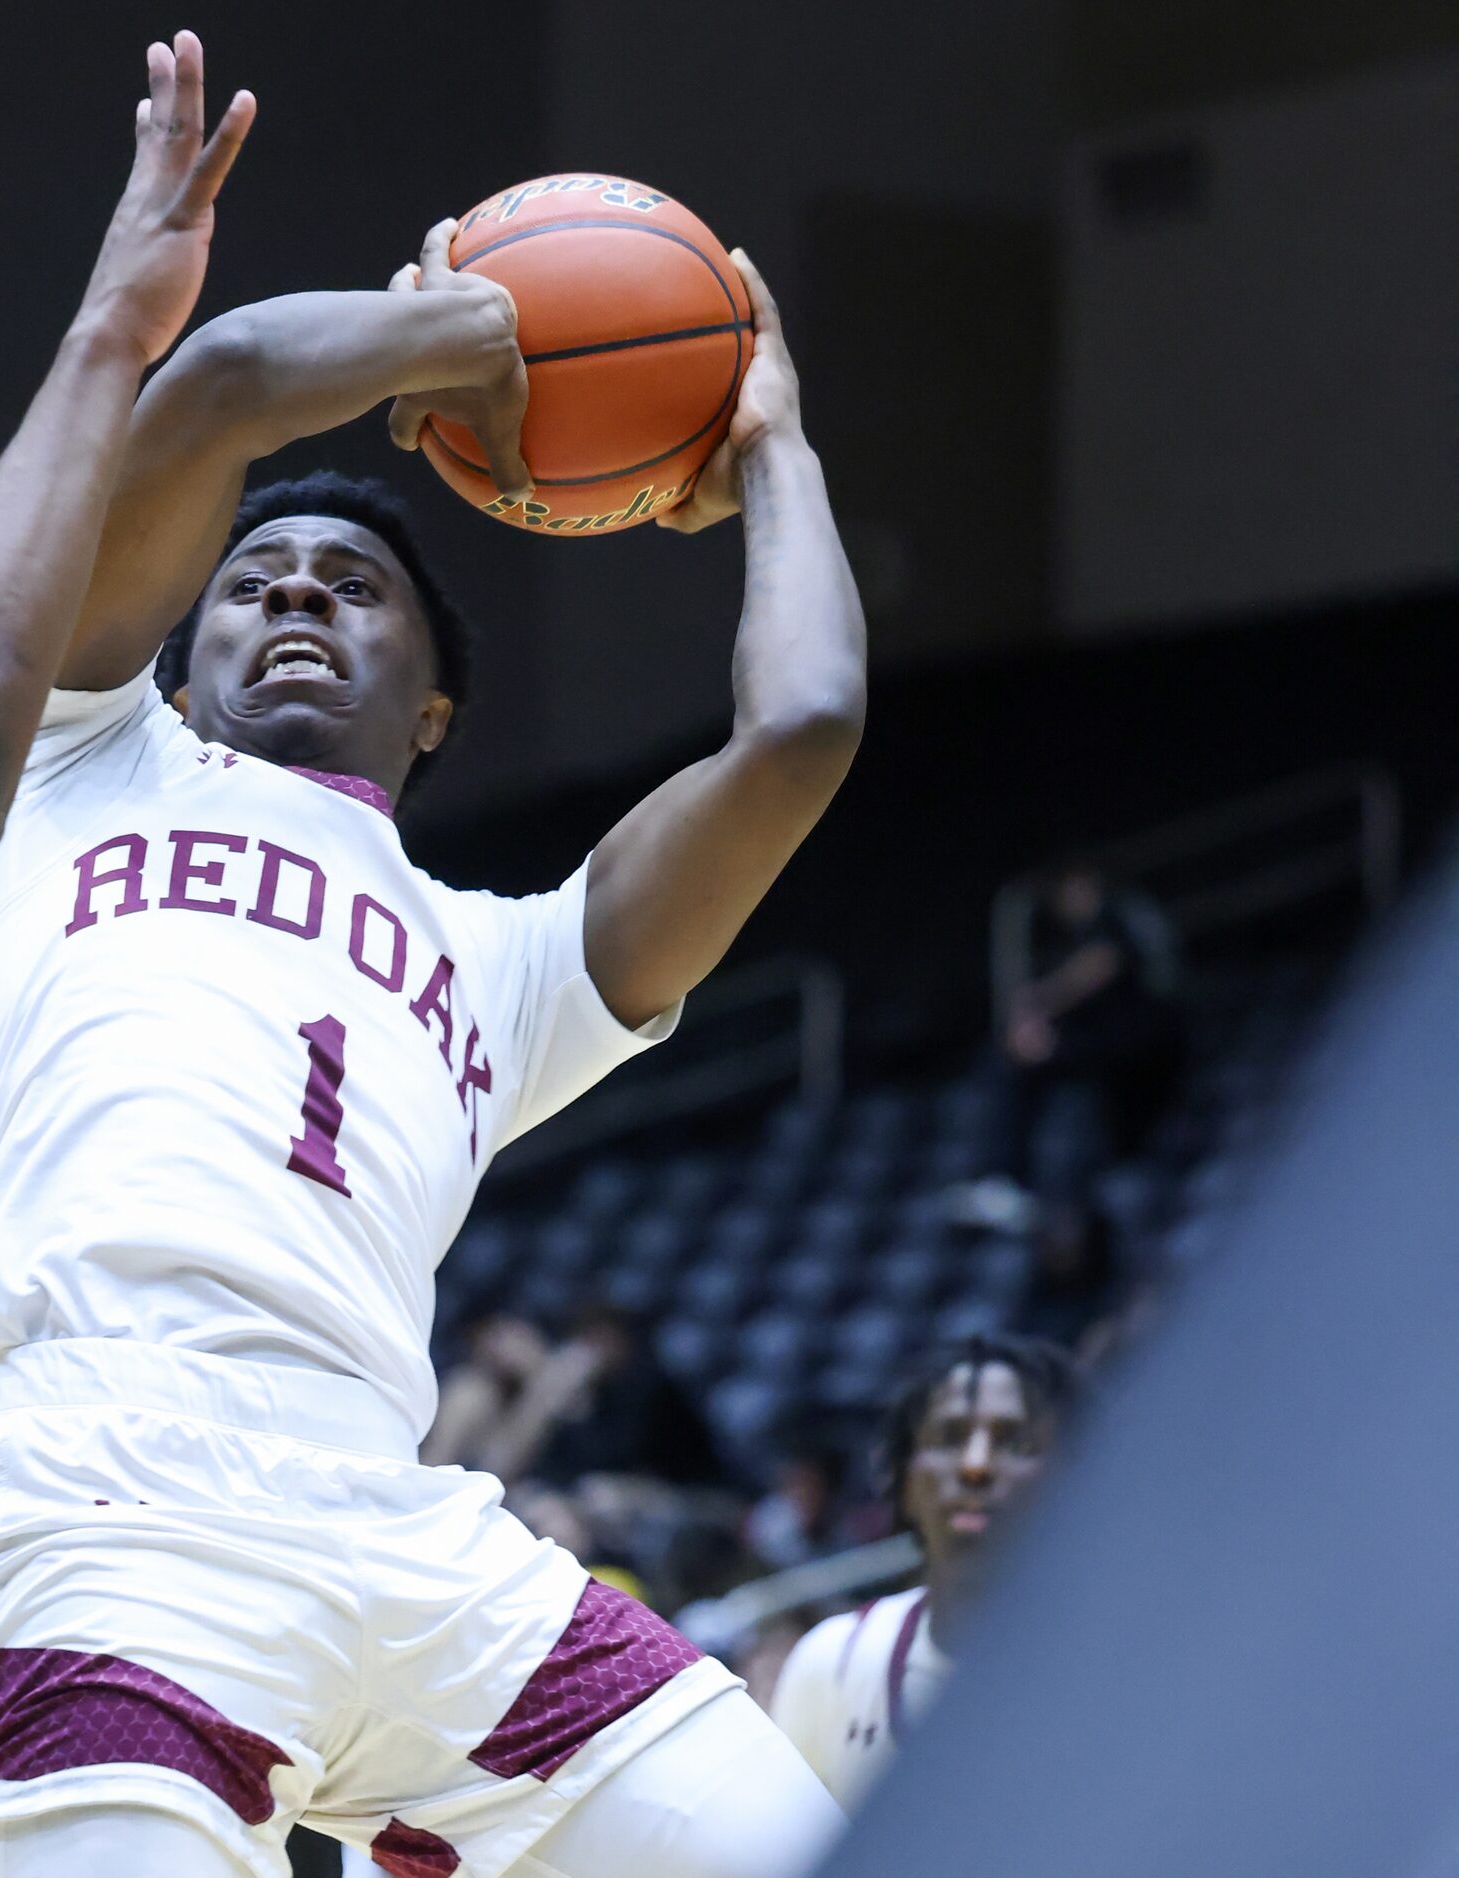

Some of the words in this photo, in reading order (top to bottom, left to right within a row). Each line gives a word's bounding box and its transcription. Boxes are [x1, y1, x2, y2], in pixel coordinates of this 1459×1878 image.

[65, 830, 327, 941] RED
[347, 893, 492, 1166] OAK
[285, 1013, 352, 1200] 1
